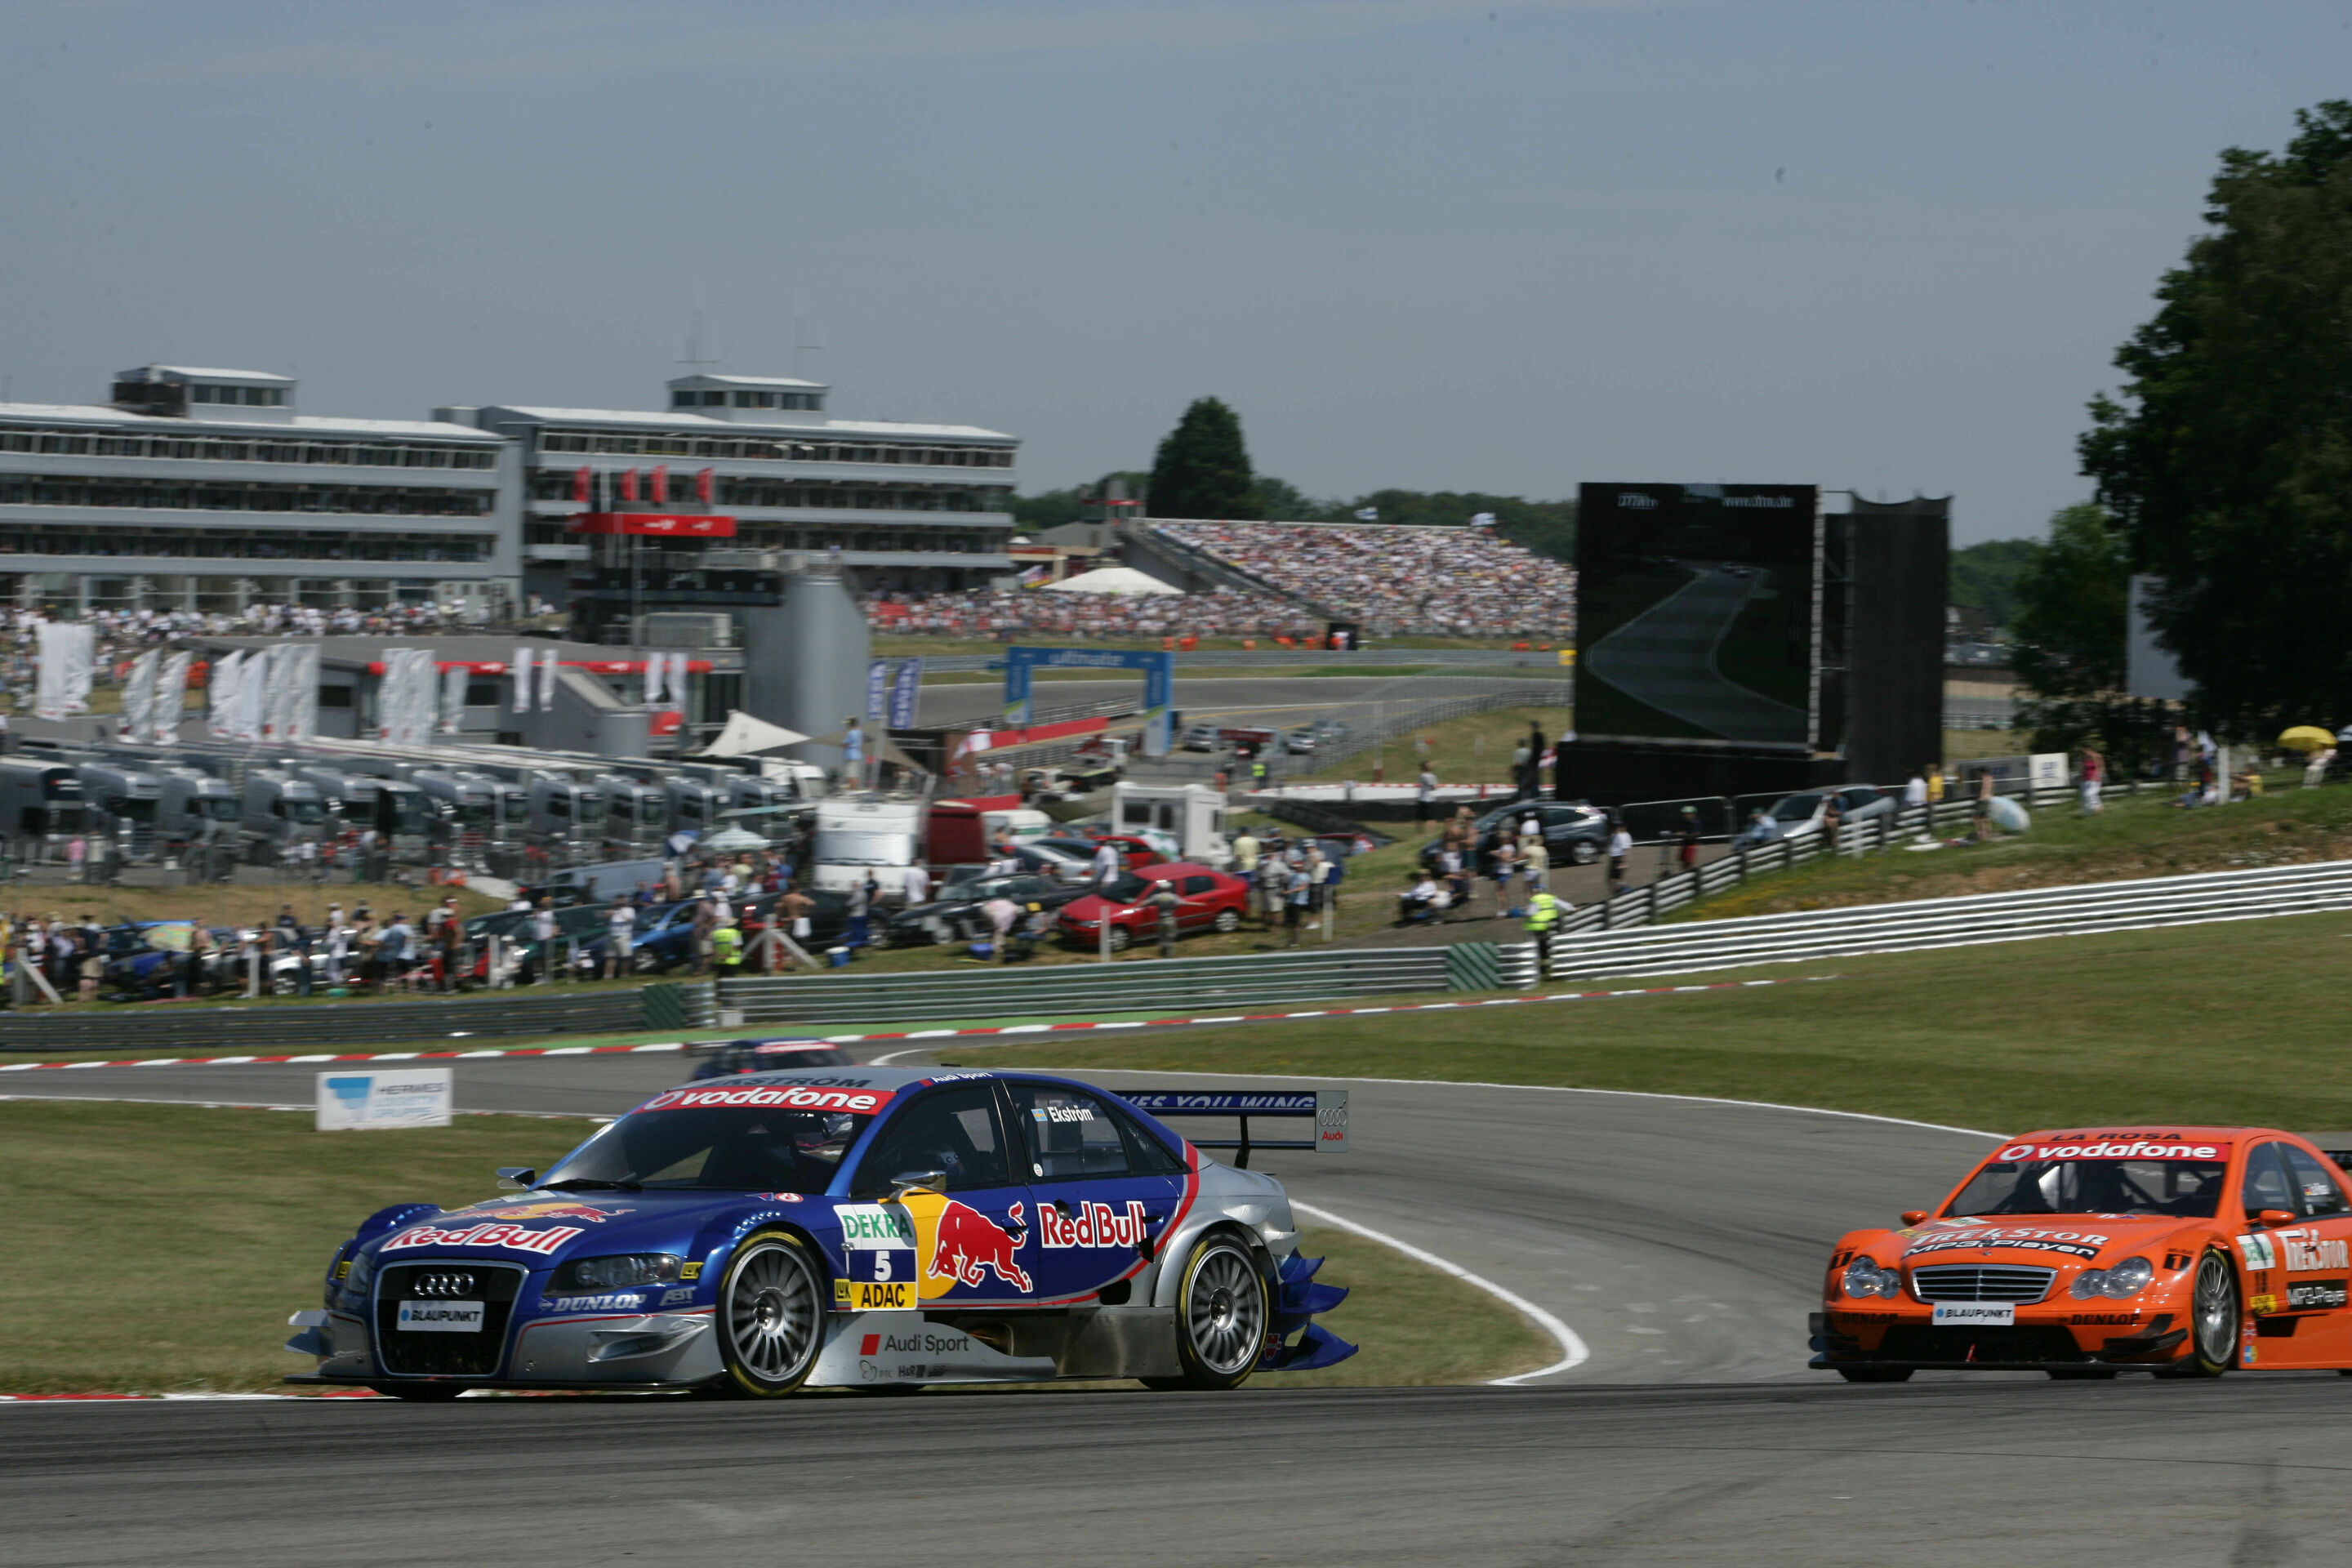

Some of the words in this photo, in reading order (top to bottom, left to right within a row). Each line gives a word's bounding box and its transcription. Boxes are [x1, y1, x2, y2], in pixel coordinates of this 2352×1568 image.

[680, 1087, 878, 1110] vodafone
[1048, 1105, 1094, 1122] Ekström
[1321, 1130, 1343, 1141] Audi
[2038, 1142, 2217, 1158] vodafone
[842, 1214, 913, 1238] DEKRA
[1039, 1203, 1094, 1246] Red
[1094, 1203, 1146, 1246] Bull
[381, 1223, 487, 1251] Red
[466, 1223, 581, 1254] Bull
[1903, 1240, 2096, 1256] MP3Player
[874, 1250, 892, 1281] 5
[553, 1294, 647, 1312] DUNLOP
[658, 1288, 697, 1307] ABT
[862, 1284, 905, 1307] ADAC
[411, 1310, 480, 1321] BLAUPUNKT
[1841, 1313, 1898, 1324] DUNLOP
[1945, 1309, 2012, 1318] BLAUPUNKT
[2070, 1314, 2140, 1325] DUNLOP
[884, 1334, 920, 1351] Audi
[924, 1334, 969, 1355] Sport
